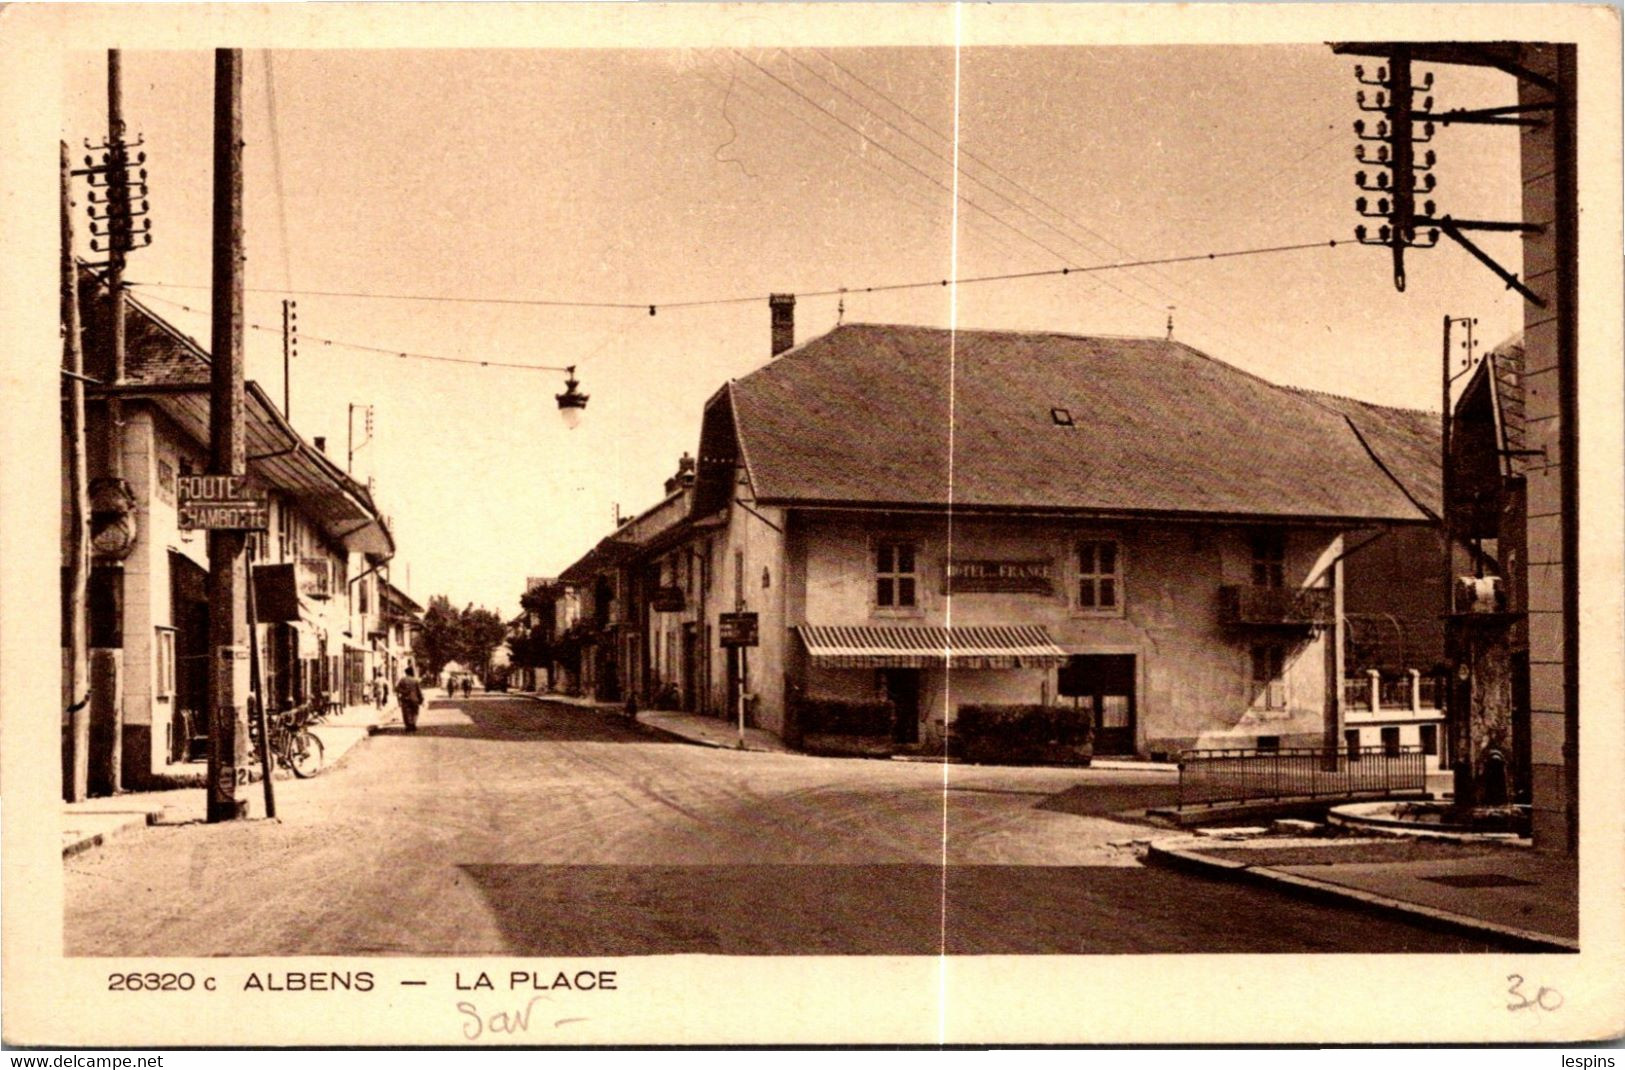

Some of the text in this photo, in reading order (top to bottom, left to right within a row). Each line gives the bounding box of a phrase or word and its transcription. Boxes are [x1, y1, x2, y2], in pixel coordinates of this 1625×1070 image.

[178, 477, 240, 499] ROUTE
[178, 508, 267, 528] CHAMBOTTE
[1506, 973, 1565, 1011] 30
